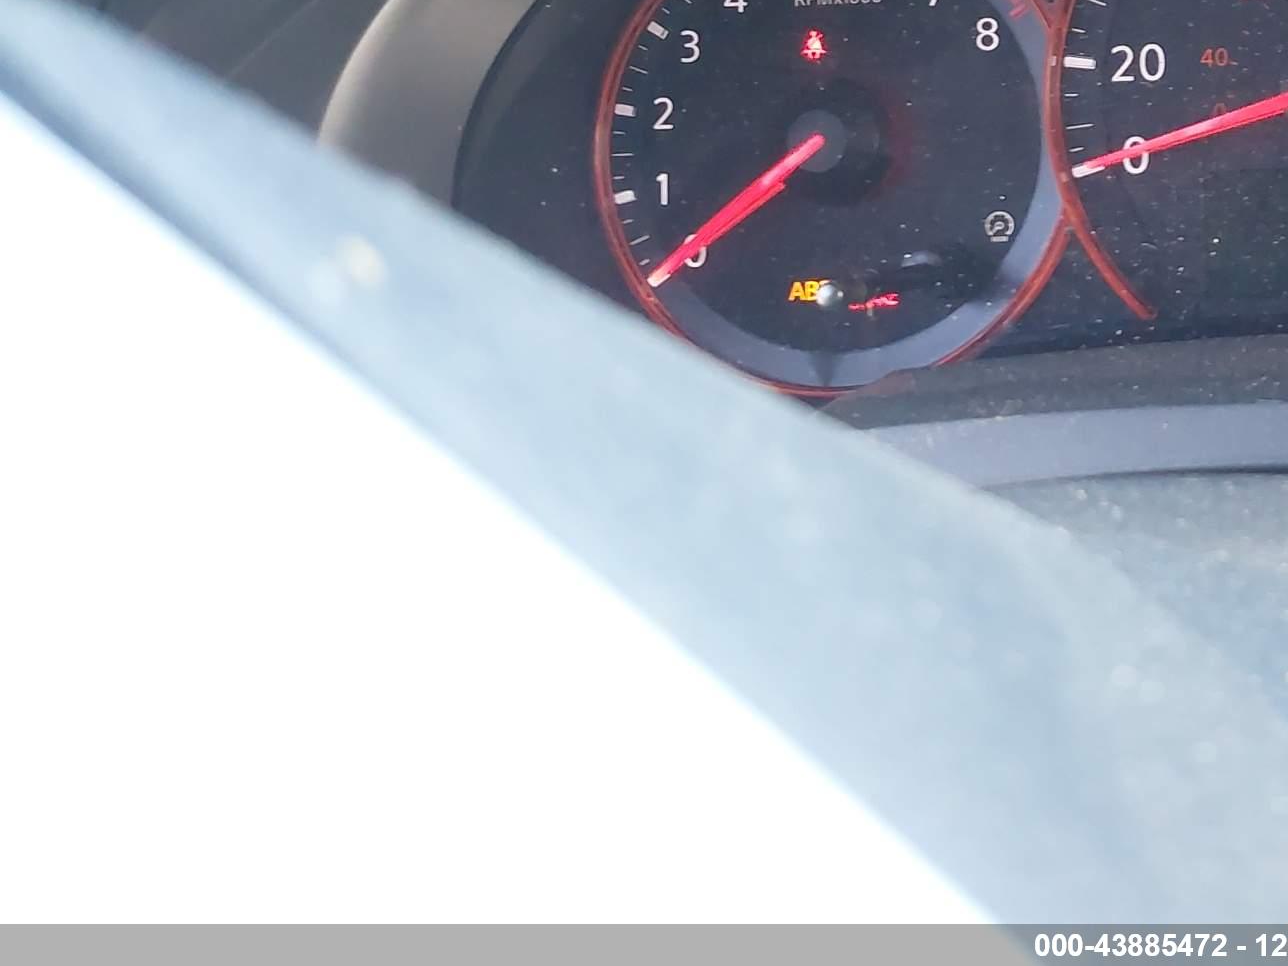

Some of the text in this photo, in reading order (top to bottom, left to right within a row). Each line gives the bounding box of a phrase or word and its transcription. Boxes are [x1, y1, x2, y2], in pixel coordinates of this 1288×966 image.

[681, 31, 700, 62] 3
[976, 18, 999, 50] 8
[1110, 44, 1165, 82] 20
[1200, 48, 1229, 67] 40
[654, 99, 674, 129] 2
[1122, 136, 1150, 174] 0
[656, 173, 668, 205] 1
[788, 280, 832, 302] AB
